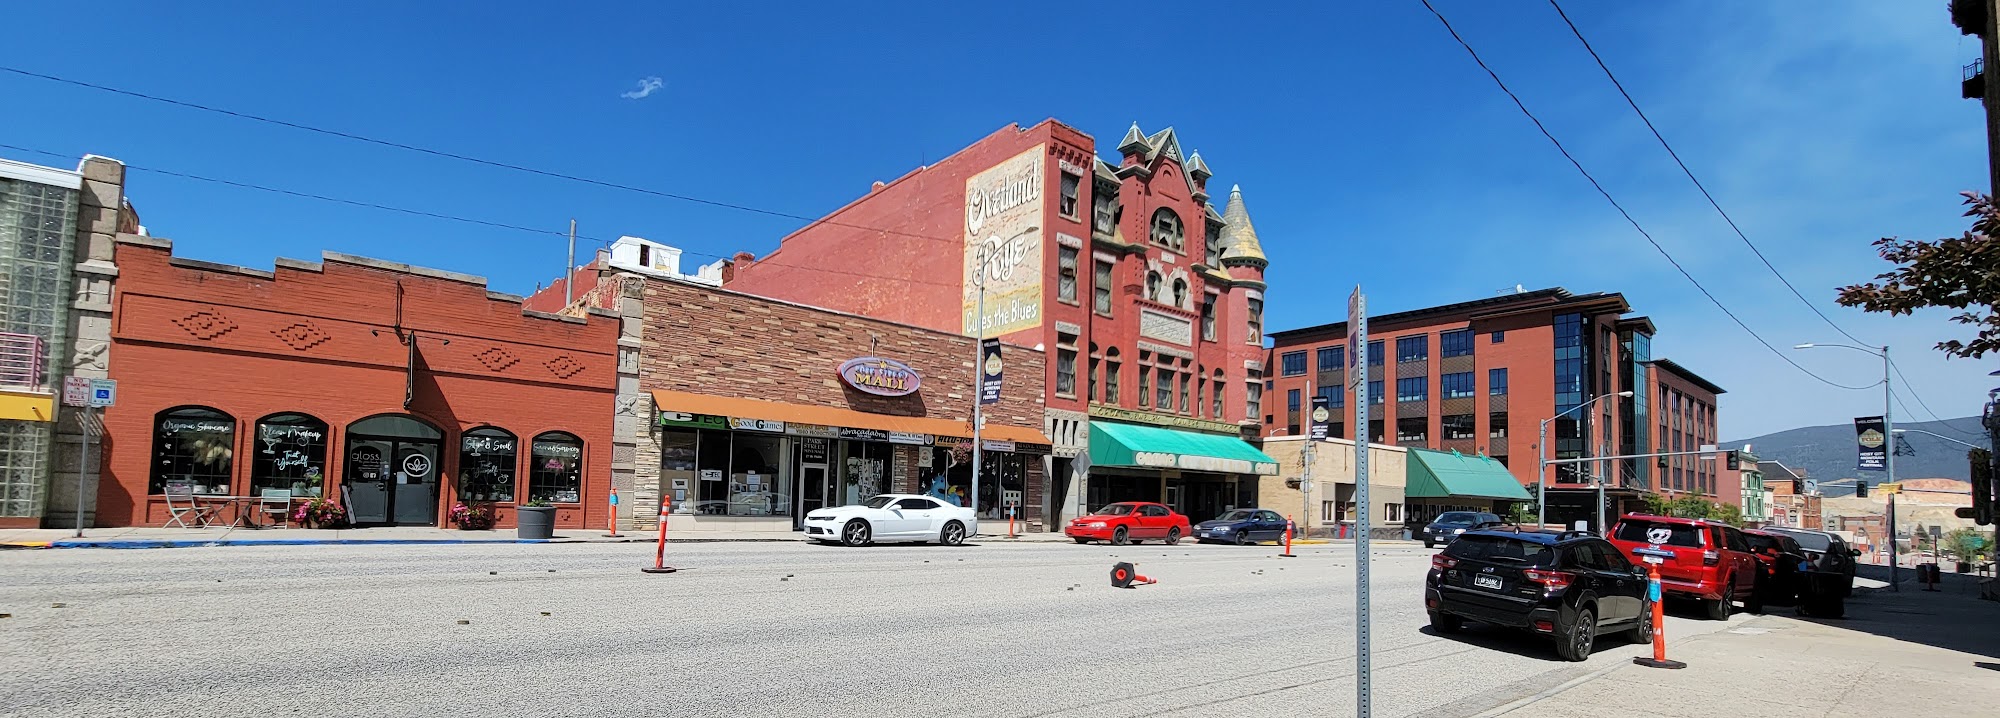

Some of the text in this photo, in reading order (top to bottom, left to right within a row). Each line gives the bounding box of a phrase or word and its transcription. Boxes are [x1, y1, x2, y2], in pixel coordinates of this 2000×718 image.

[967, 156, 1040, 236] Overland
[972, 235, 1025, 287] Rye
[966, 299, 1037, 334] Cues the Blues
[855, 373, 909, 391] MALL
[197, 421, 230, 432] Skincare
[731, 417, 754, 428] Good
[756, 420, 782, 430] Games
[288, 428, 321, 441] Makeup
